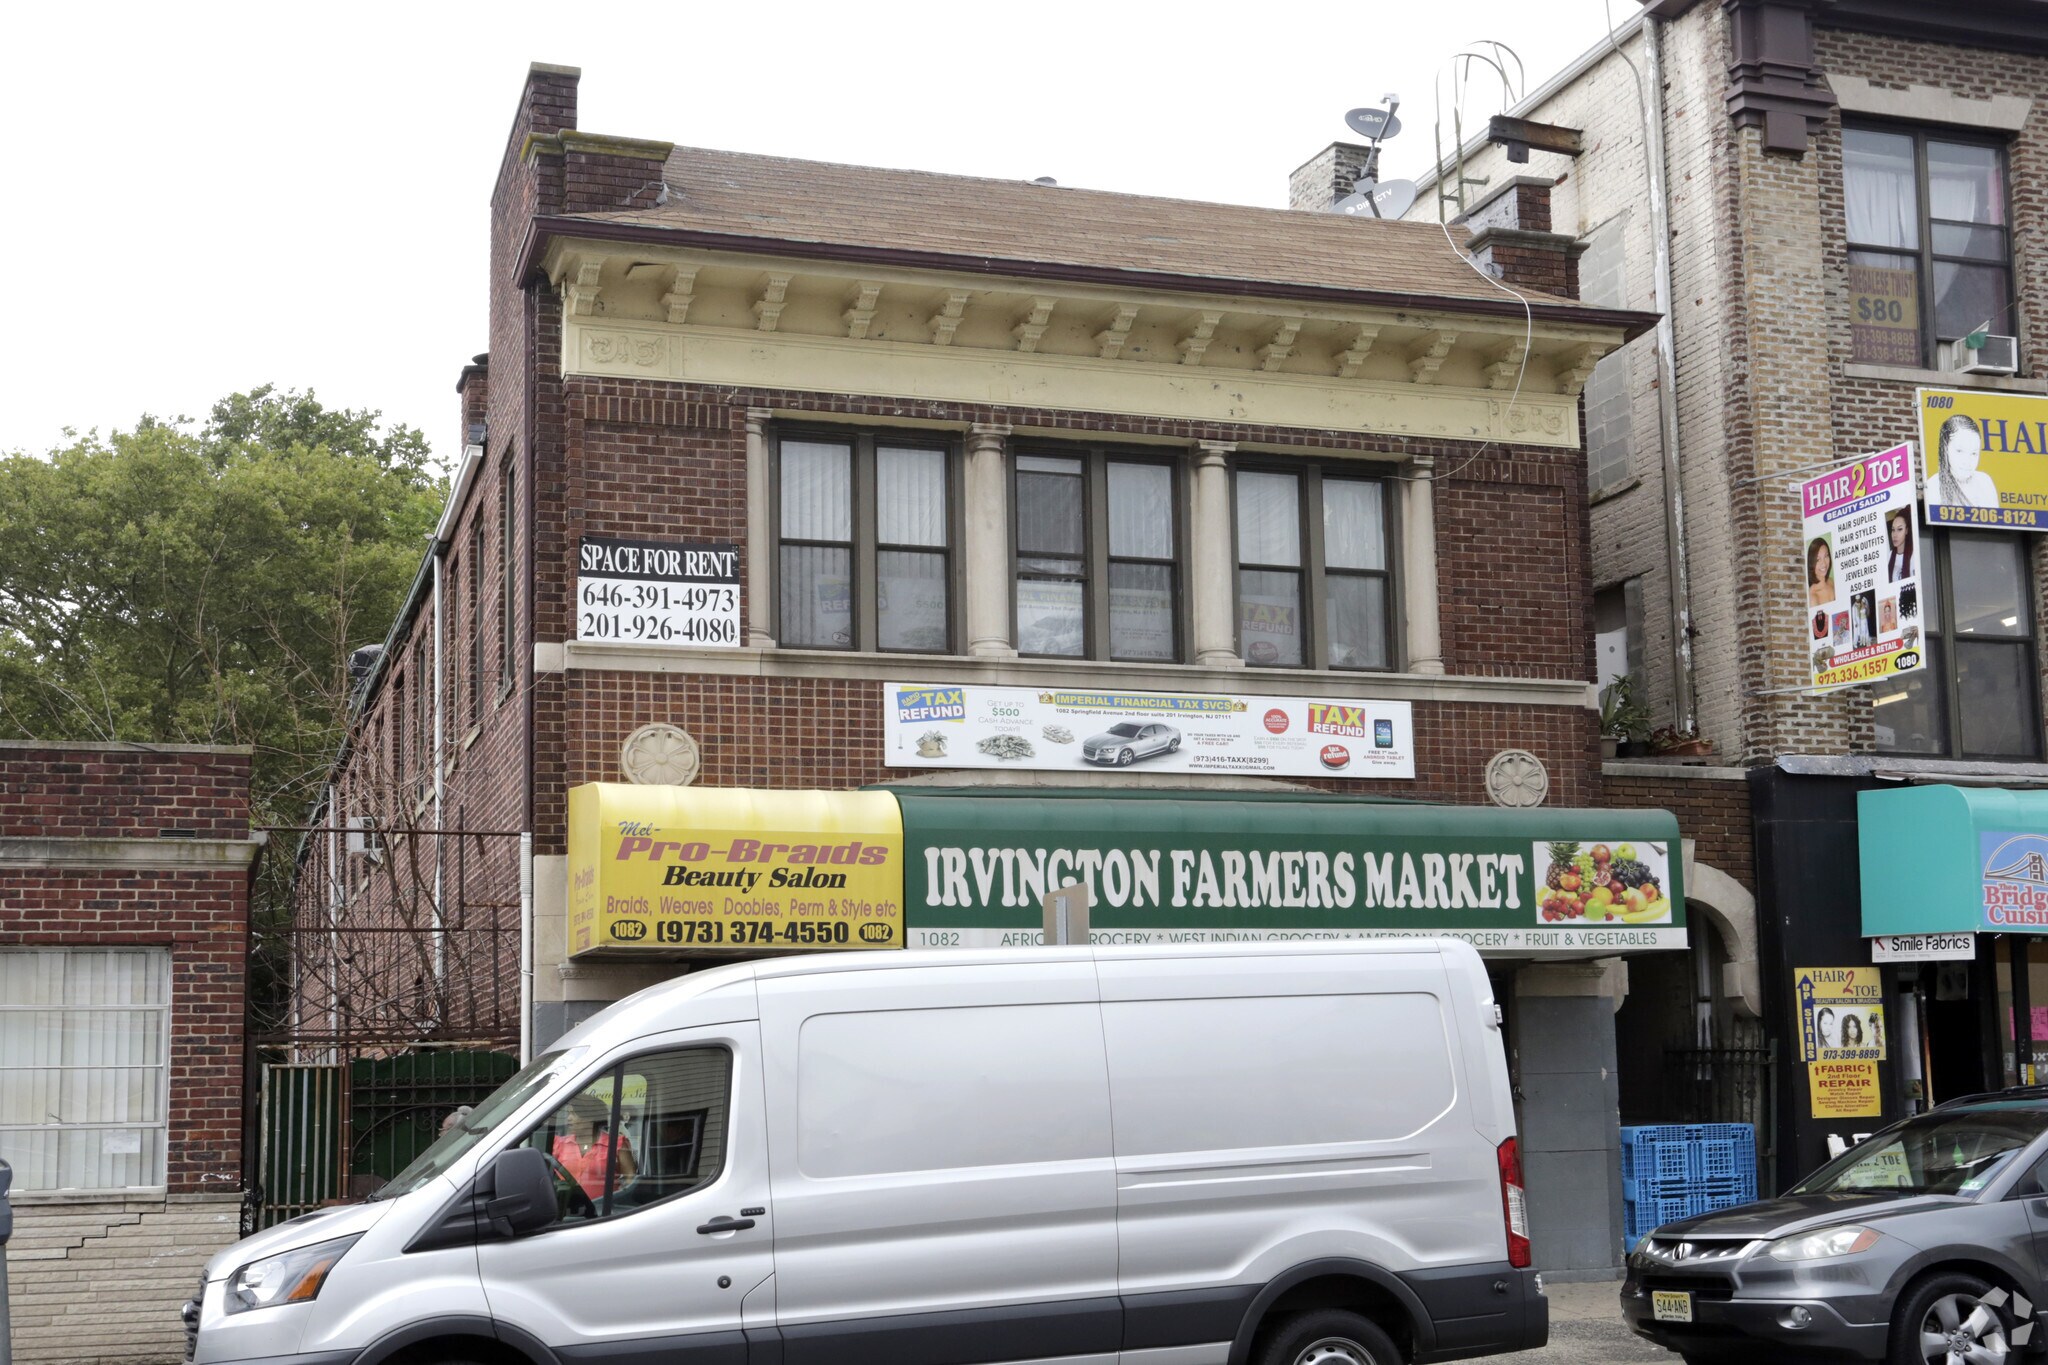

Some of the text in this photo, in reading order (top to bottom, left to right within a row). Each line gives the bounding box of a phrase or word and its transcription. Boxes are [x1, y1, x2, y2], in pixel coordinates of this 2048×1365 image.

[1858, 296, 1902, 323] $80
[1853, 344, 1917, 363] 73-336-1557
[1926, 395, 1954, 409] 1080
[1979, 418, 2048, 455] HAI
[1808, 455, 1904, 511] HAIR 2 TOE
[1826, 492, 1888, 521] BEAUTY SALON
[2000, 492, 2048, 506] BEAUTY
[1837, 511, 1878, 533] HAIR SUPLIES
[1939, 506, 2037, 525] 973-206-8124
[1839, 525, 1877, 545] HAIR STYLES
[1834, 535, 1885, 560] AFRICAN OUTFITS
[580, 543, 737, 578] SPACE FOR RENT
[1840, 556, 1859, 571] SHOES
[1863, 551, 1880, 566] BAGS
[1844, 564, 1878, 583] JEWELRIES
[1850, 578, 1874, 593] ASO-EBI
[582, 581, 735, 613] 646-391-4973
[1241, 602, 1292, 626] TAX
[582, 612, 736, 644] 201-926-4080
[1242, 621, 1293, 635] REFUND
[1833, 641, 1899, 665] WHOLESALE & RETAIL
[1896, 654, 1918, 670] 1080
[1818, 657, 1888, 685] 973.336.1557
[922, 690, 962, 706] TAX
[1056, 694, 1232, 711] IMPERIAL FINANCIAL TAX SVCS
[900, 705, 964, 721] REFUND
[978, 716, 1034, 726] CASH ADVANCE
[992, 707, 1020, 717] $500
[1070, 708, 1102, 716] Springfield
[1308, 703, 1363, 727] TAX
[1313, 723, 1364, 737] REFUND
[1323, 750, 1348, 761] refund
[1327, 745, 1341, 753] tax
[615, 836, 889, 866] Pro-Braids
[660, 865, 848, 895] Beauty Salon
[924, 847, 1525, 910] IRVINGTON FARMERS MARKET
[1998, 882, 2013, 891] The
[1984, 884, 2048, 911] Bridg
[606, 895, 653, 917] Braids,
[660, 896, 714, 914] Weaves
[723, 897, 784, 918] Doobies,
[789, 898, 827, 916] Perm
[828, 899, 838, 915] &
[841, 898, 872, 920] Style
[875, 900, 897, 918] etc
[613, 920, 890, 944] 1082 (973) 374-4550 1082
[920, 931, 960, 947] 1082
[1000, 932, 1044, 947] AFRIC
[1089, 932, 1151, 945] ROCERY
[1168, 932, 1206, 943] WEST
[1211, 933, 1262, 942] INDIAN
[1525, 932, 1561, 946] FRUIT
[1564, 932, 1575, 946] &
[1578, 932, 1658, 946] VEGETABLES
[1891, 934, 1970, 952] Smile Fabrics
[1812, 970, 1879, 997] HAIR 2 TOE
[1803, 1008, 1815, 1059] STAIRS
[1822, 1049, 1880, 1060] 973-399-8899
[1821, 1064, 1866, 1073] FABRIC
[1818, 1079, 1871, 1088] REPAIR
